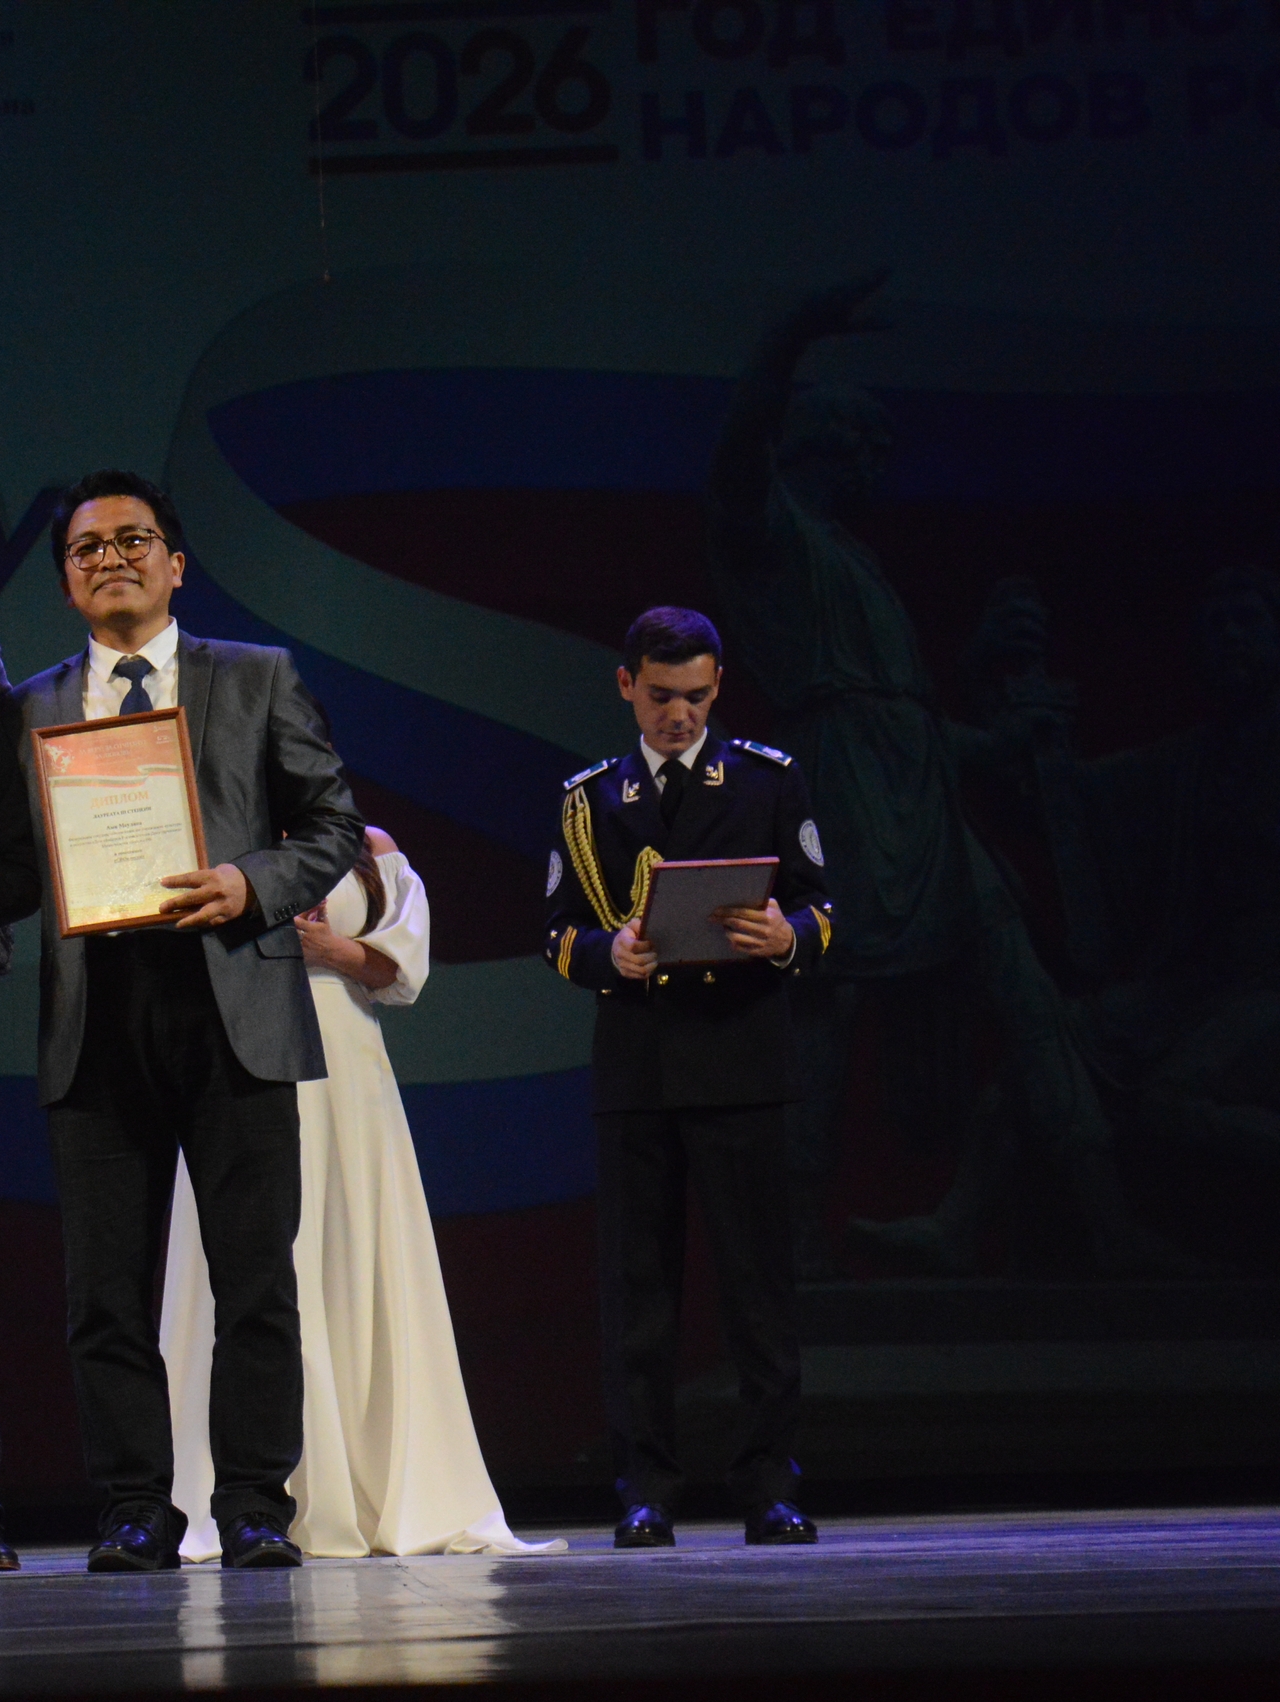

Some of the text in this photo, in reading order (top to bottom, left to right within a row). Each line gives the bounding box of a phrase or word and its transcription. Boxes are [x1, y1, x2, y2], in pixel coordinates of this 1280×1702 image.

[635, 0, 1280, 69] ГОД ЕДИНС
[303, 23, 613, 143] 2026
[638, 71, 1152, 163] НАРОДОВ
[91, 790, 149, 809] ДИПЛОМ
